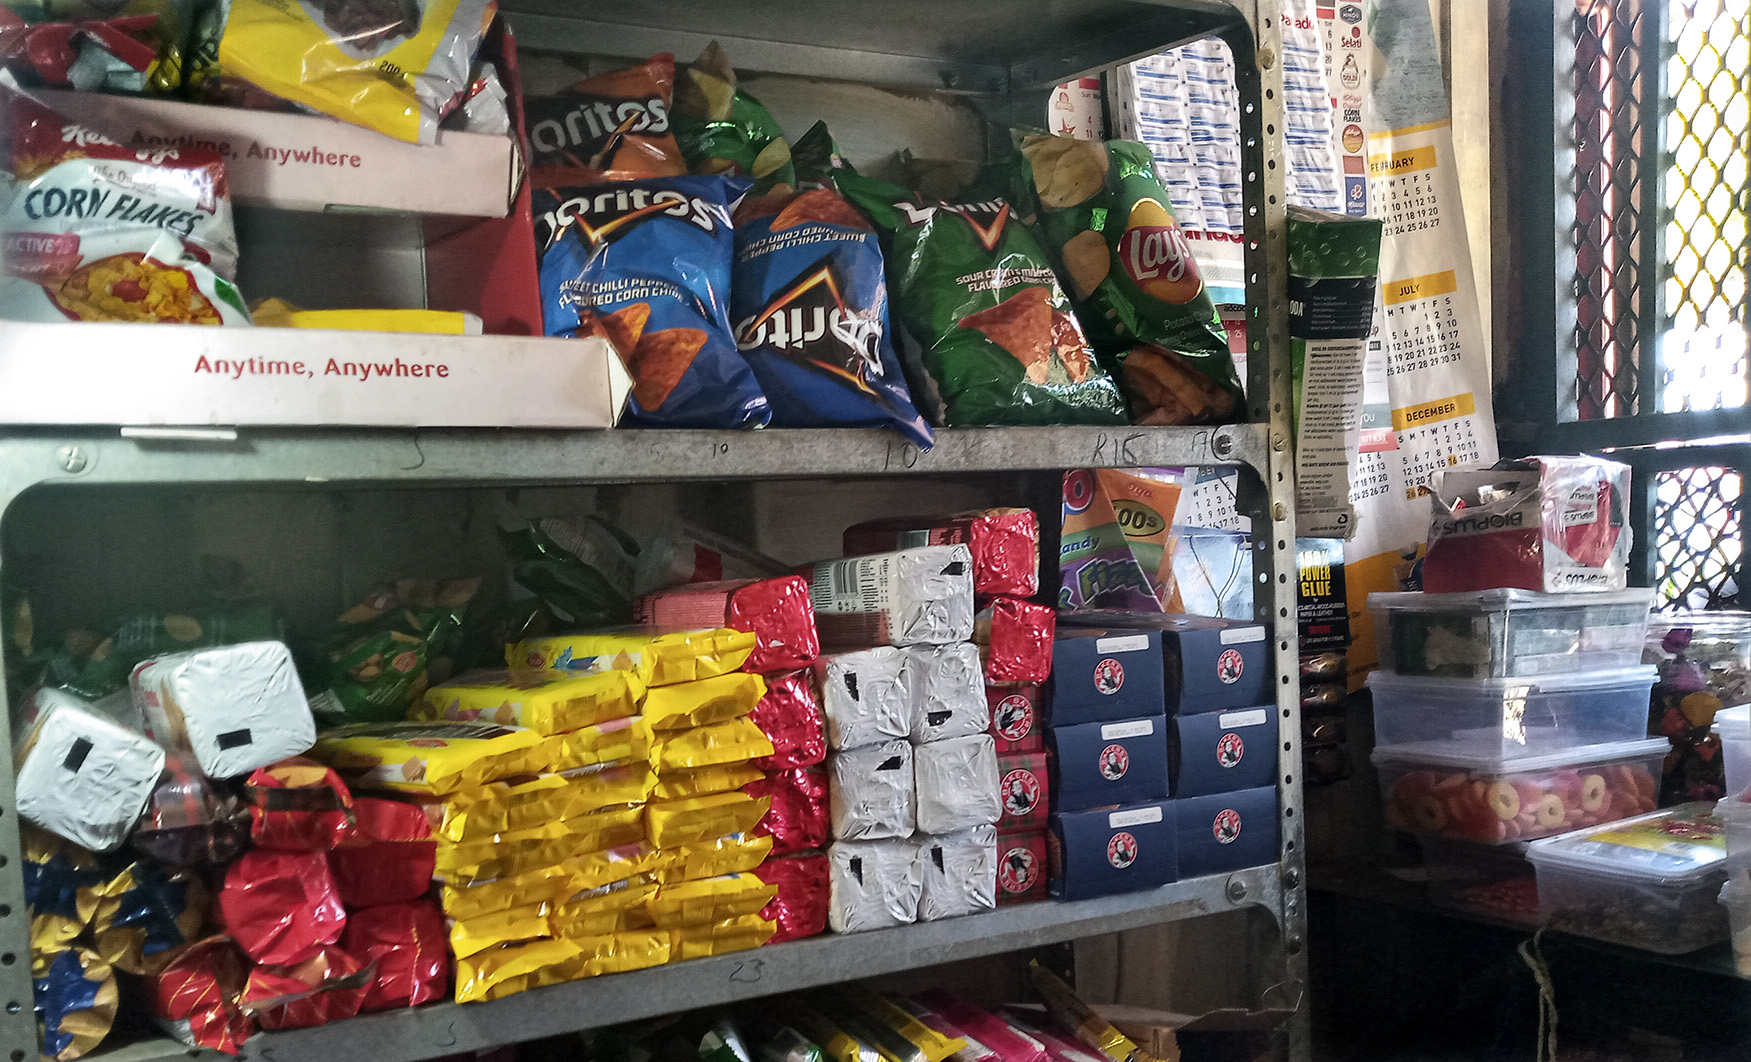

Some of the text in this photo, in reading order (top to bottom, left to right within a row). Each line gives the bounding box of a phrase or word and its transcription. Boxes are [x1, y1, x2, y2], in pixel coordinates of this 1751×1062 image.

[1325, 43, 1332, 51] 13
[1341, 35, 1361, 48] Selati
[528, 99, 669, 154] oritos
[1086, 129, 1092, 138] 11
[247, 140, 362, 168] Anywhere
[1371, 157, 1414, 171] FEBRUARY
[1381, 193, 1385, 201] 2
[1392, 192, 1396, 200] 3
[1415, 187, 1420, 195] 5
[1392, 196, 1437, 211] 10 11 12 13
[24, 188, 204, 237] CORN FLAKES
[1383, 207, 1438, 224] 16 17 18 19 20
[1384, 218, 1439, 236] 23 24 25 26 27
[768, 231, 799, 244] CORN
[787, 235, 822, 248] CHILLI
[592, 279, 628, 293] CHILLI
[955, 272, 984, 285] SOUR
[968, 276, 1021, 293] FLAVURED
[1399, 284, 1420, 296] JULY
[559, 292, 613, 310] FLOURED
[616, 288, 649, 303] CORN
[1290, 300, 1303, 317] ODA
[1434, 311, 1440, 319] 2
[1164, 315, 1194, 331] Potato
[1392, 332, 1397, 340] 5
[1404, 329, 1409, 337] 6
[1436, 322, 1441, 330] 9
[1446, 319, 1457, 328] 10
[735, 306, 884, 377] Dorito
[1393, 330, 1459, 351] 12 13 14 15 16 17
[1395, 342, 1460, 362] 19 20 21 22 23 24
[195, 355, 449, 381] Anytime, Anywhere
[1396, 365, 1405, 374] 26
[1407, 363, 1416, 371] 27
[1419, 360, 1428, 369] 28
[1430, 358, 1438, 366] 29
[1451, 353, 1461, 361] 31
[1406, 403, 1456, 422] DECEMBER
[1445, 435, 1450, 443] 2
[1457, 432, 1462, 440] 3
[712, 442, 729, 459] 10
[884, 441, 918, 471] 10
[1403, 457, 1408, 465] 5
[1414, 454, 1419, 462] 6
[1436, 449, 1441, 457] 8
[1448, 446, 1453, 454] 9
[1457, 443, 1466, 451] 10
[1403, 468, 1412, 476] 12
[1414, 465, 1423, 473] 13
[1437, 459, 1446, 468] 15
[1448, 457, 1458, 465] 16
[1459, 454, 1467, 462] 17
[1369, 476, 1376, 484] 19
[1379, 473, 1388, 482] 20
[1405, 479, 1414, 487] 19
[1416, 476, 1425, 485] 20
[1354, 493, 1360, 501] 24
[1362, 490, 1369, 498] 25
[1370, 487, 1378, 496] 26
[1380, 484, 1389, 493] 27
[1407, 490, 1416, 499] 26
[1206, 499, 1211, 507] 2
[1217, 496, 1222, 504] 3
[1118, 508, 1158, 529] 00s
[1188, 507, 1226, 524] 7 8 9 10
[1219, 516, 1239, 528] 17 18
[1441, 511, 1523, 535] BIOPLUS
[1300, 565, 1331, 581] POWER
[1301, 581, 1331, 597] GLUE
[1012, 696, 1033, 735] BAKERS
[1001, 771, 1039, 796] BAKERS
[729, 959, 765, 983] 23
